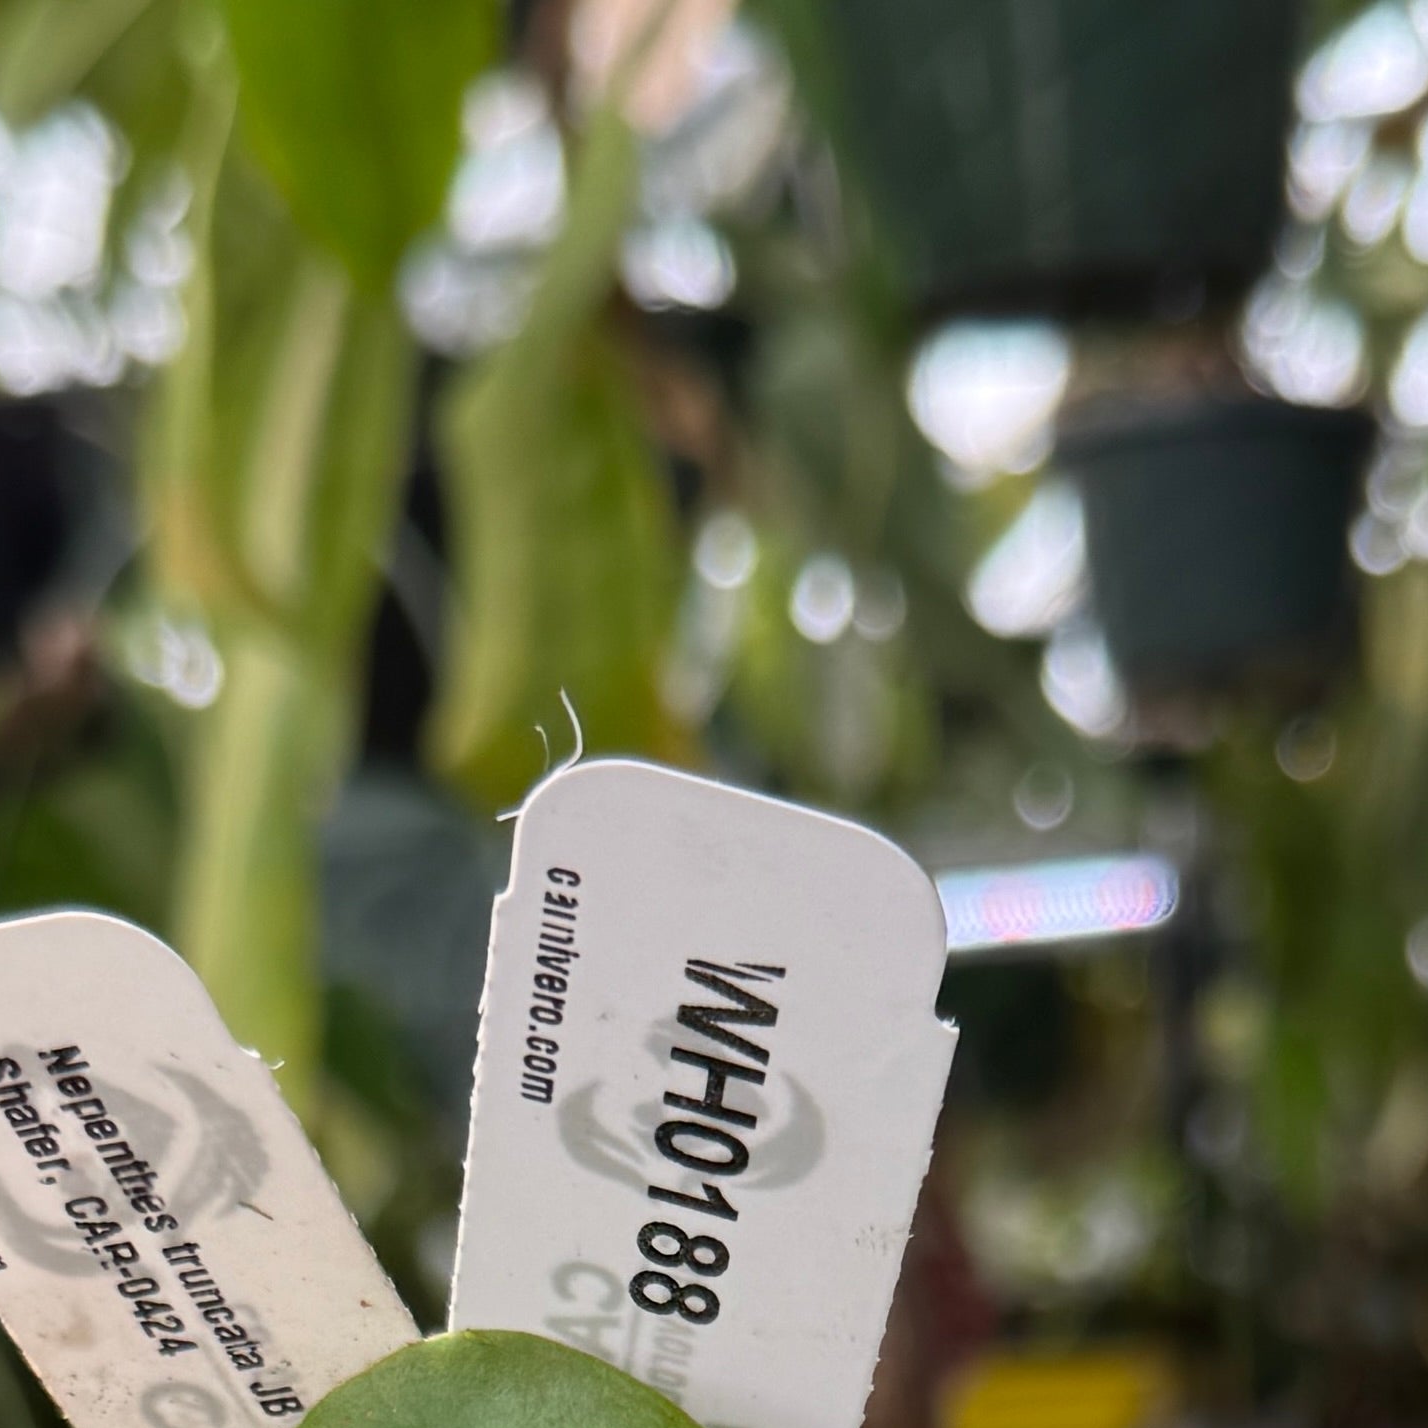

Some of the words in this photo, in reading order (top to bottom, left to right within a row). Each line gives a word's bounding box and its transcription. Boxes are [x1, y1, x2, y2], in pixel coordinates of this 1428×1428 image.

[38, 1044, 177, 1235] Nepenthes
[162, 1240, 265, 1373] truncata
[251, 1379, 306, 1418] JB
[65, 1195, 197, 1358] CAR-0424
[628, 957, 786, 1325] WH0188
